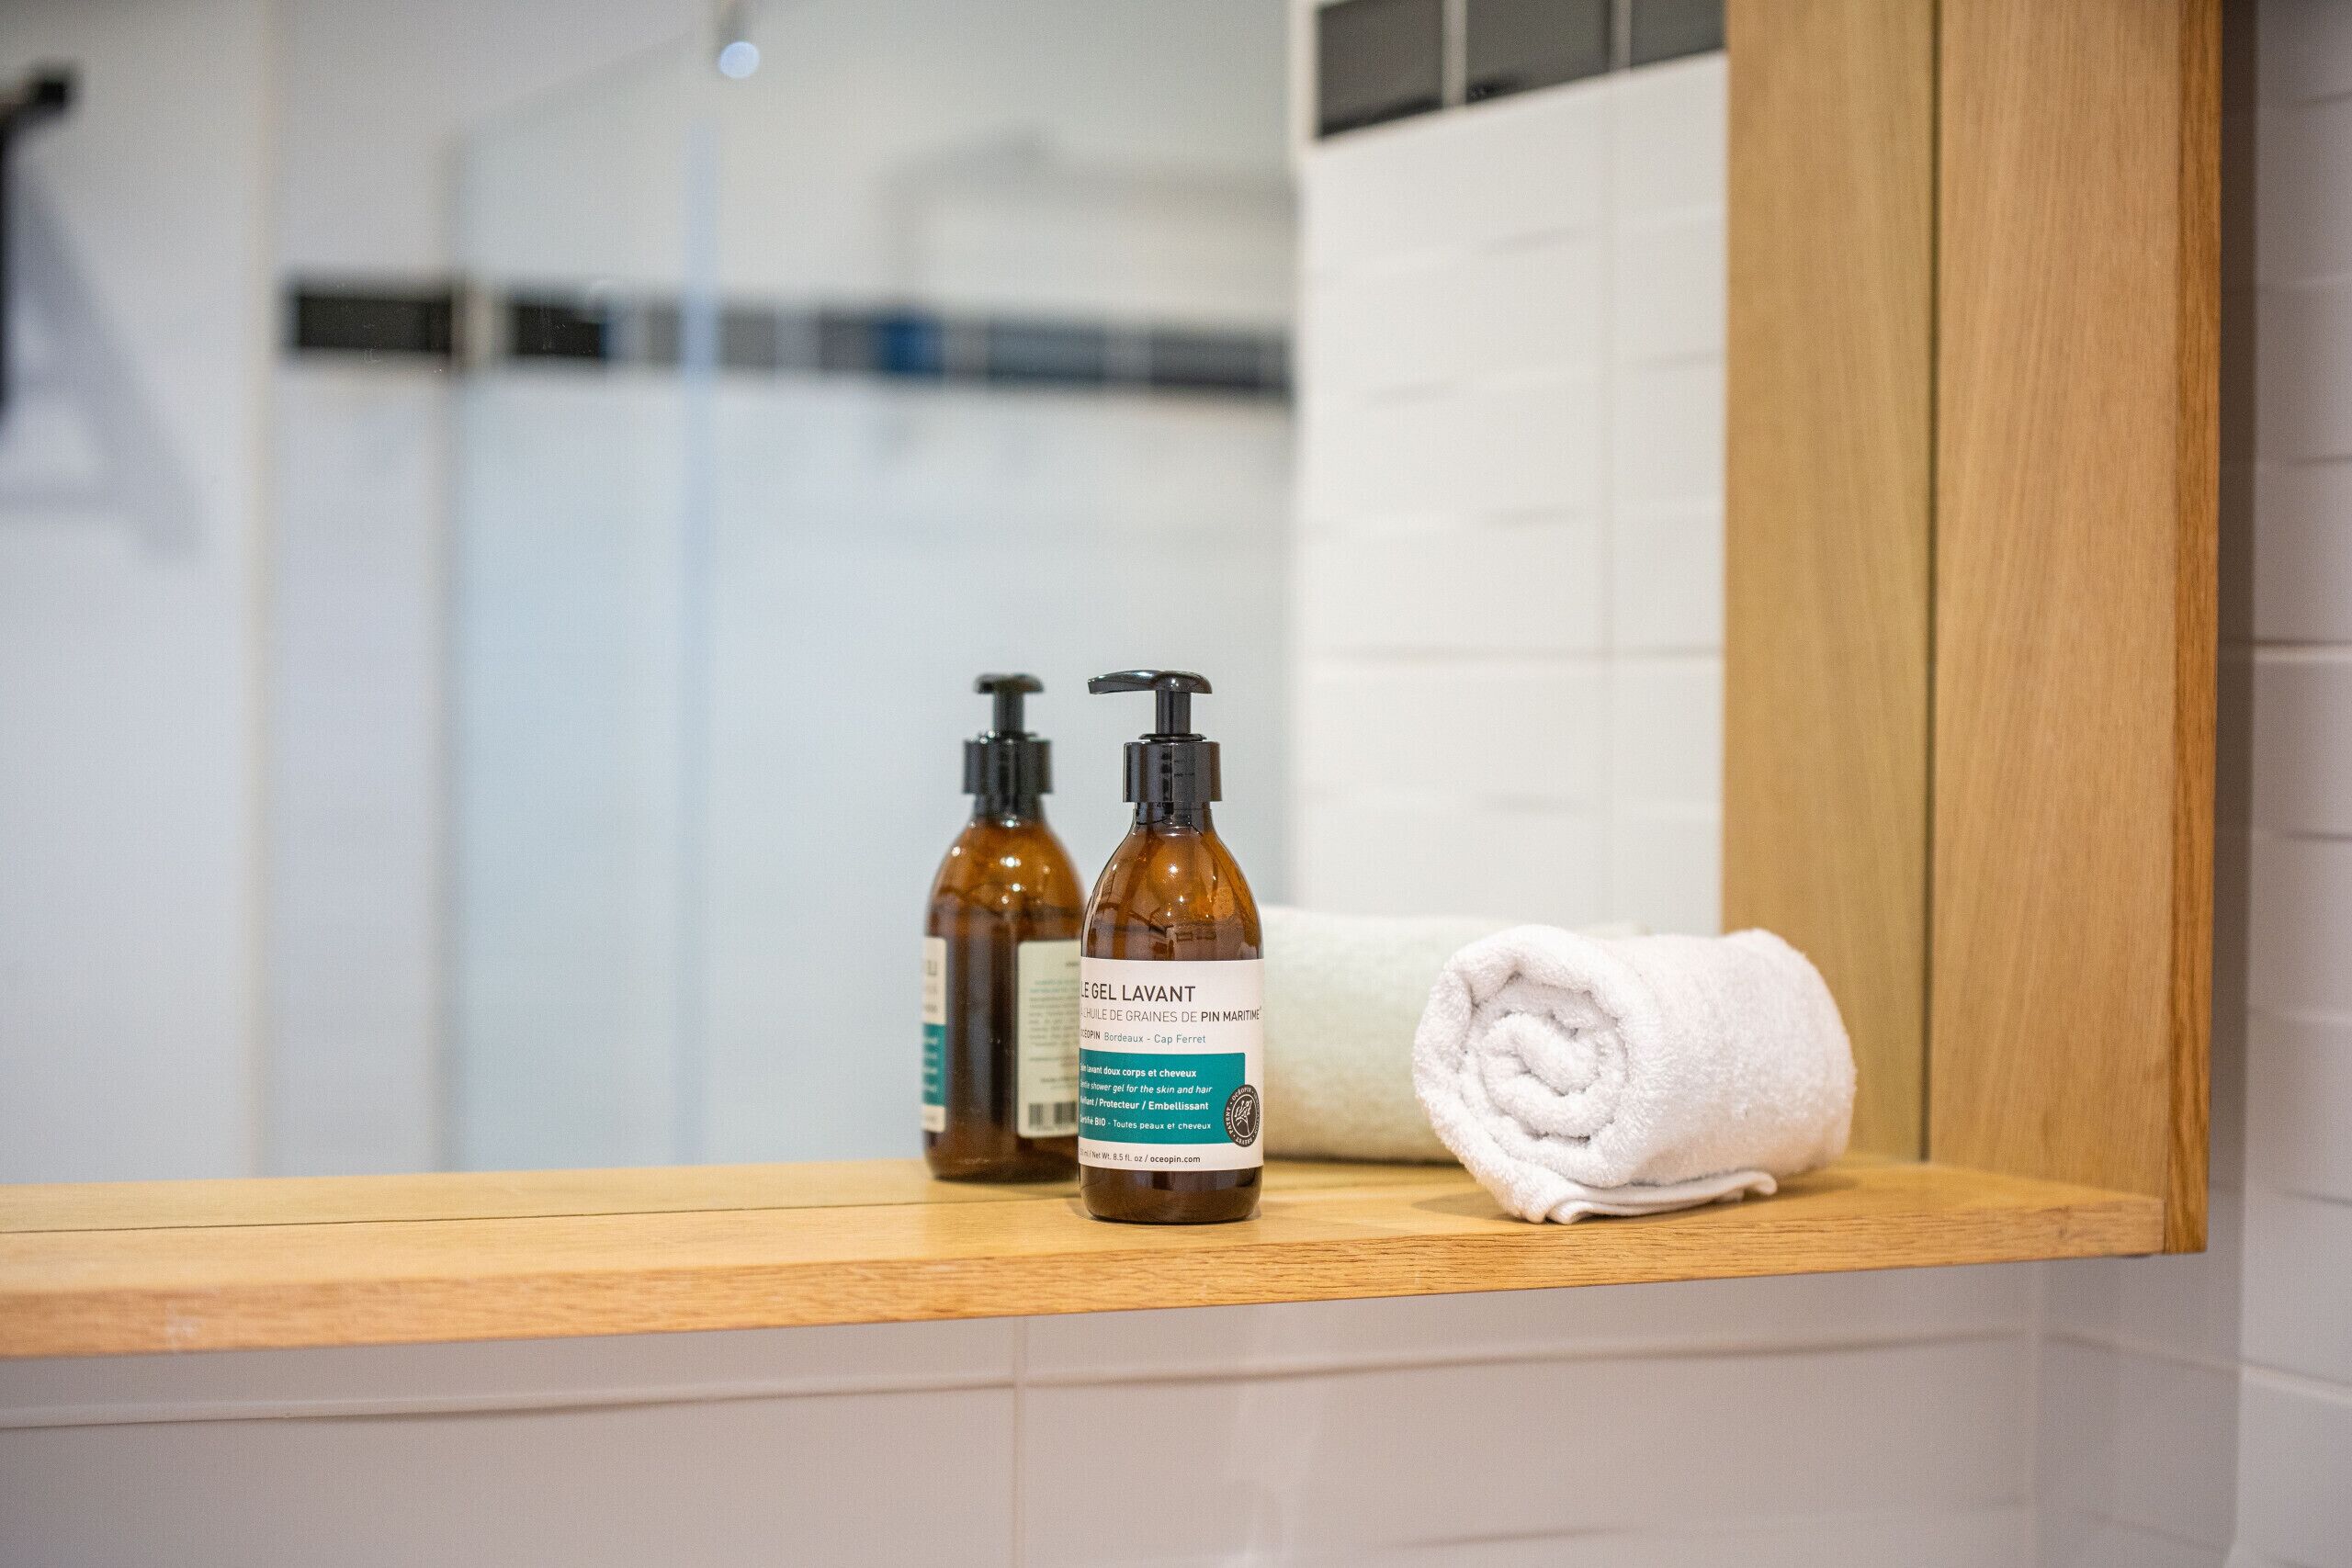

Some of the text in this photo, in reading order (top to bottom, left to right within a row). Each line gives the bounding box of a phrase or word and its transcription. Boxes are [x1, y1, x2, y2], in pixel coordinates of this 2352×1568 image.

[1080, 980, 1090, 998] LE
[1091, 982, 1117, 1001] GEL
[1122, 985, 1196, 1002] LAVANT
[1109, 1009, 1123, 1021] DE
[1125, 1010, 1178, 1022] GRAINES
[1182, 1011, 1198, 1022] DE
[1201, 1011, 1220, 1022] PIN
[1104, 1032, 1144, 1043] Bordeaux
[1154, 1033, 1173, 1045] Cap
[1176, 1034, 1206, 1043] Ferret
[1086, 1064, 1102, 1075] lavant
[1103, 1066, 1121, 1076] doux
[1122, 1069, 1147, 1078] corps
[1148, 1068, 1158, 1077] et
[1159, 1068, 1197, 1077] cheveux
[1091, 1082, 1112, 1091] shower
[1113, 1084, 1125, 1094] gel
[1126, 1084, 1139, 1093] for
[1140, 1085, 1154, 1094] the
[1156, 1085, 1175, 1094] skin
[1177, 1085, 1194, 1094] and
[1195, 1085, 1214, 1094] hair
[1099, 1098, 1140, 1110] Protecteur
[1148, 1100, 1209, 1111] Embellissant
[1094, 1117, 1106, 1127] BIO
[1113, 1119, 1137, 1129] Toutes
[1092, 1150, 1102, 1159] Net
[1102, 1152, 1112, 1161] Wt.
[1113, 1153, 1124, 1162] 8.5
[1149, 1155, 1201, 1165] oceopin.com
